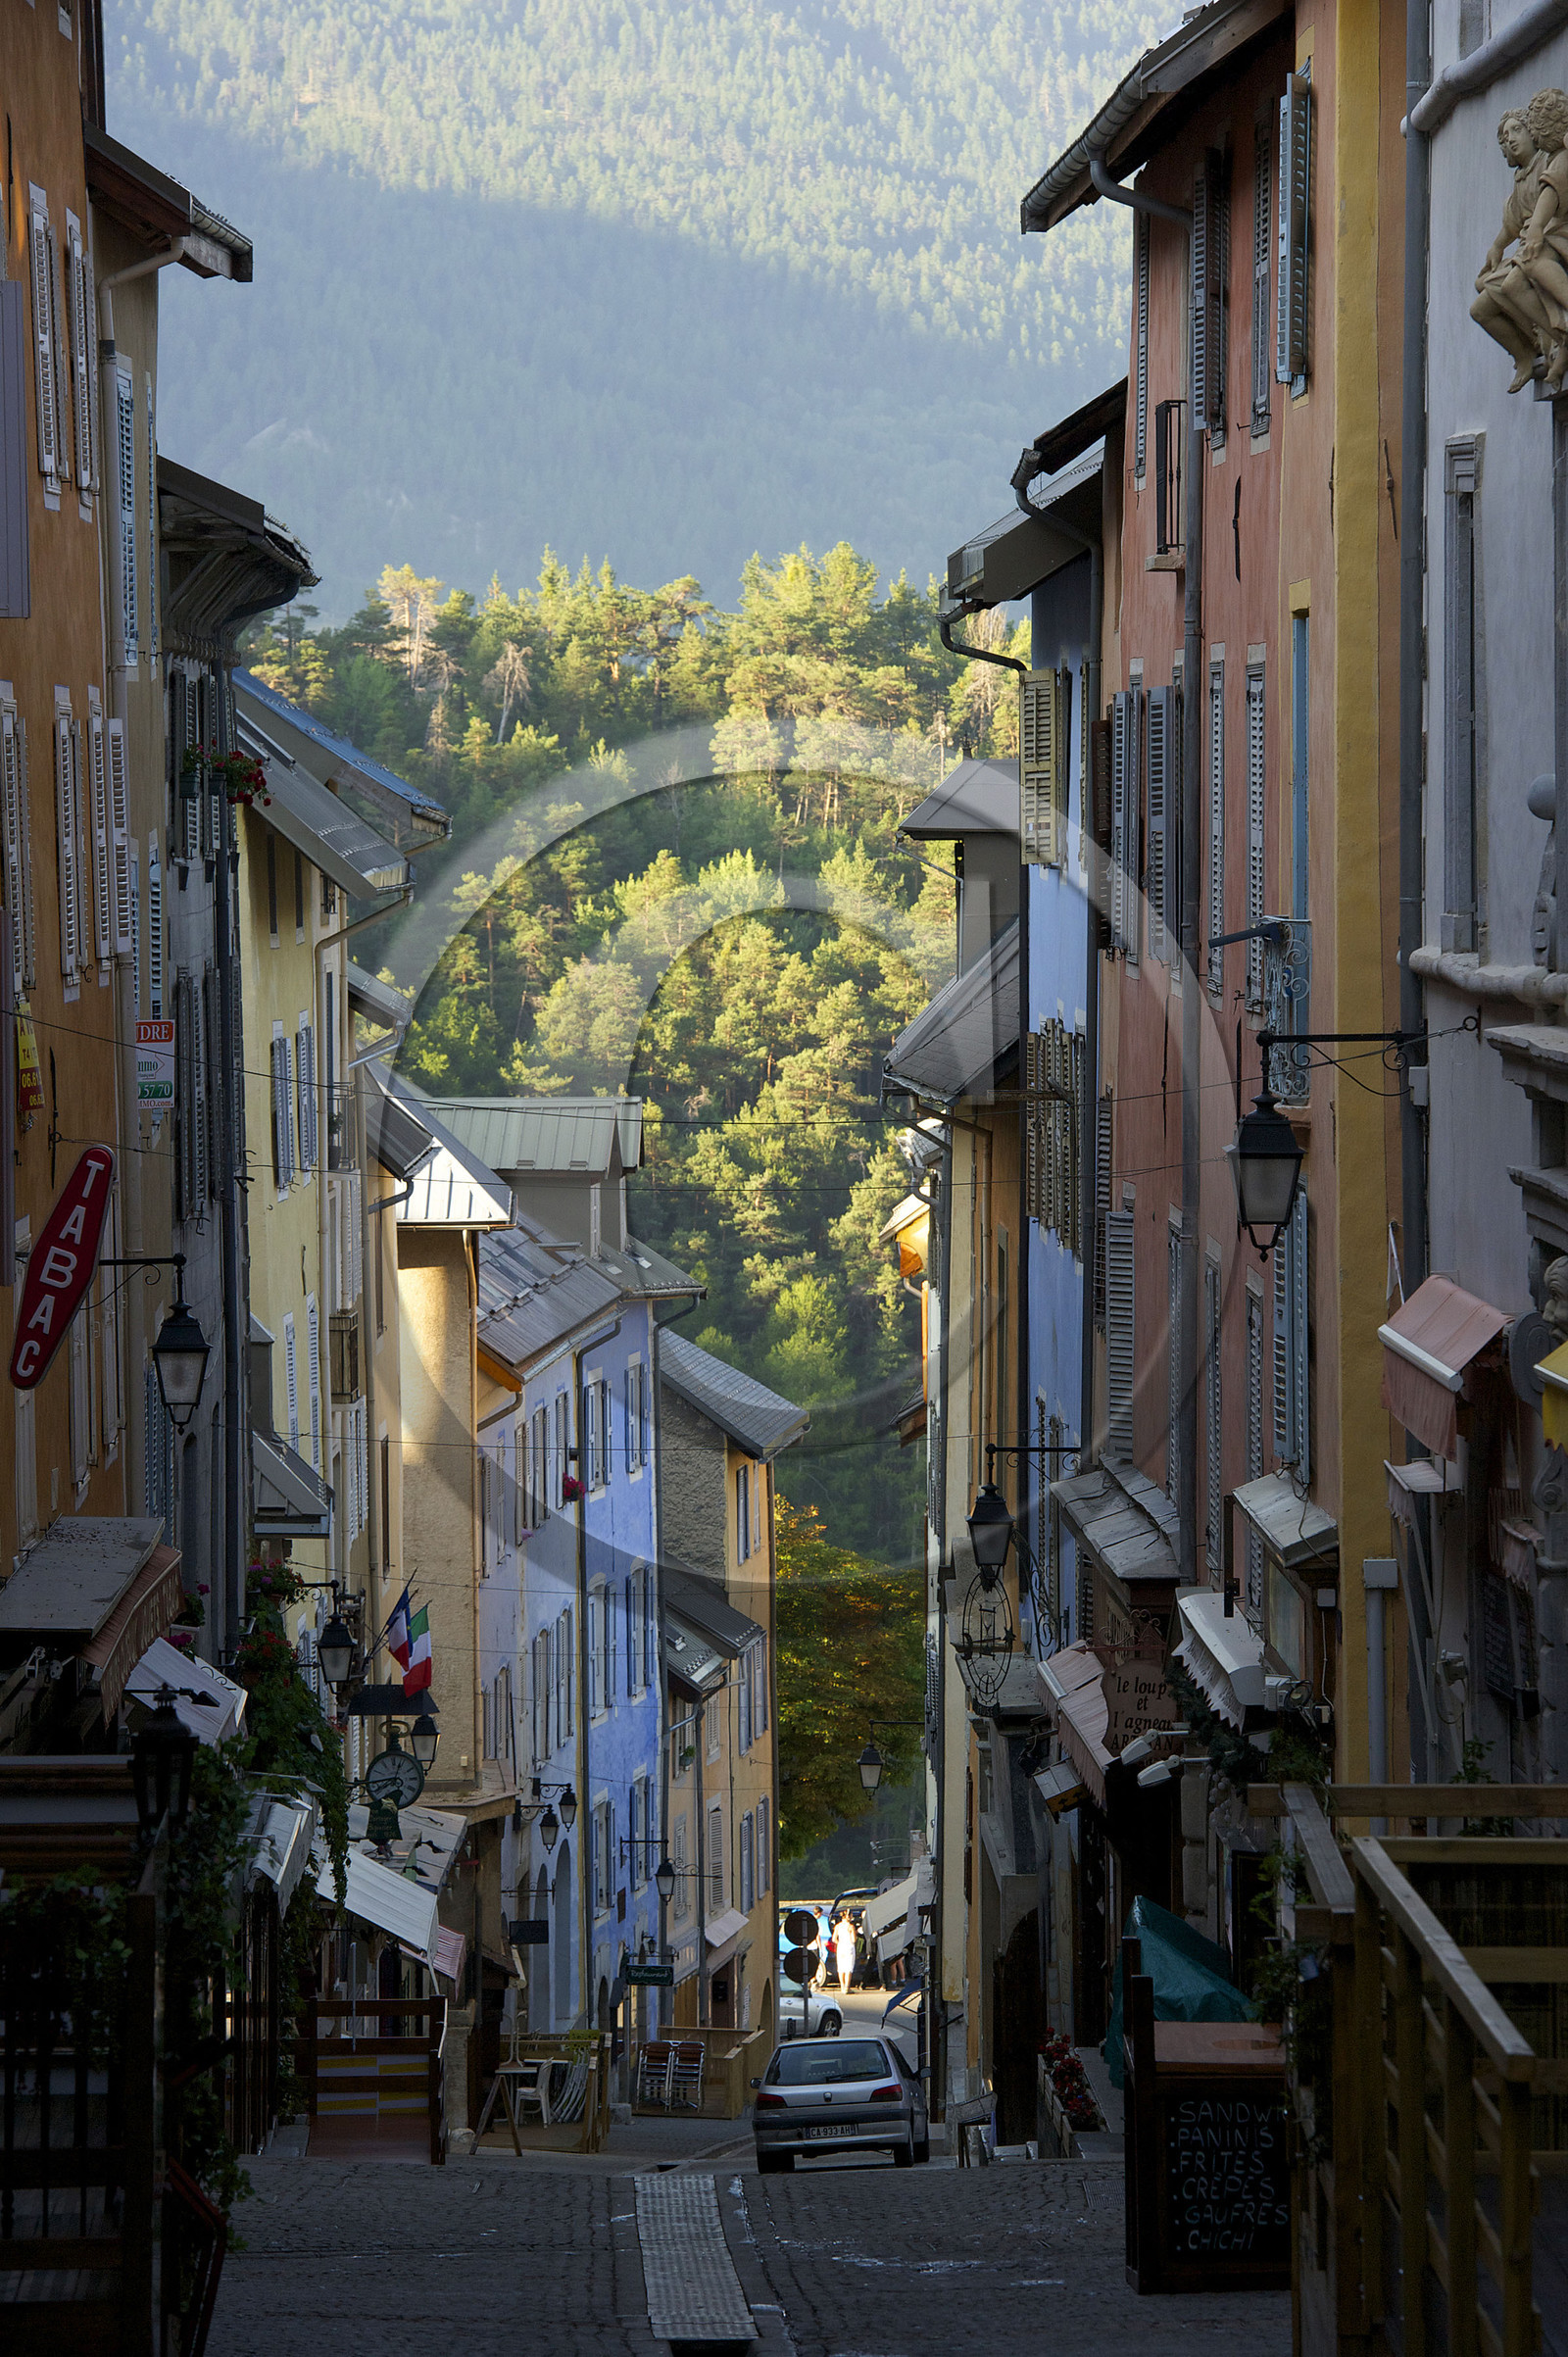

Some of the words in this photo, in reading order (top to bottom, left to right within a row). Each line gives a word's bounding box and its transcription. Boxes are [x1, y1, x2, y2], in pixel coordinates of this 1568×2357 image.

[136, 1024, 170, 1041] DRE
[143, 1084, 155, 1098] 57
[158, 1083, 171, 1097] 70
[16, 1159, 105, 1378] TABAC
[1117, 1676, 1130, 1694] le
[1134, 1676, 1167, 1700] loup
[1136, 1694, 1149, 1711] et
